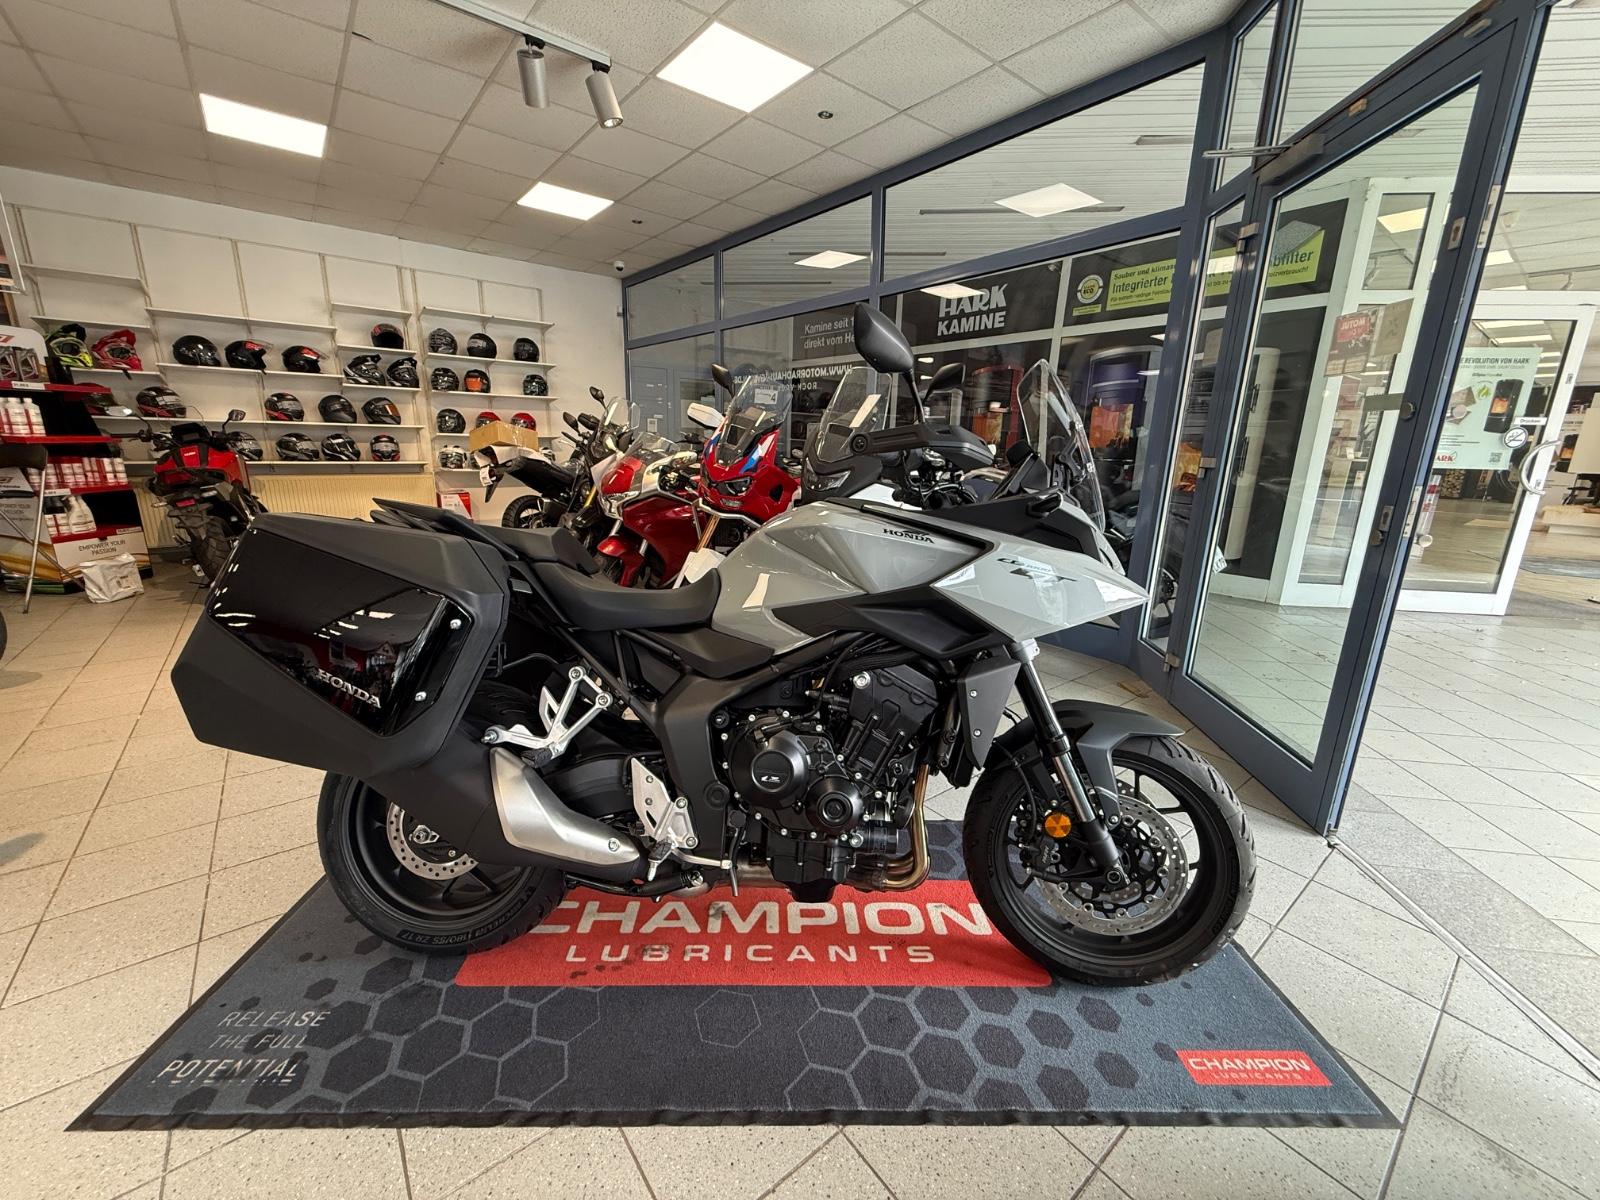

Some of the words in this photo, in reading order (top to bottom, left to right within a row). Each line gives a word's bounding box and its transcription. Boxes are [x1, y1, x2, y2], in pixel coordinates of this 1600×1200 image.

[1270, 250, 1314, 267] bfilter
[1114, 270, 1136, 281] Sauber
[1137, 267, 1150, 276] und
[1112, 275, 1168, 294] Integrierter
[939, 283, 1008, 318] HARK
[804, 321, 832, 335] Kamine
[833, 317, 849, 330] seit
[937, 311, 1006, 336] KAMINE
[803, 336, 825, 349] direkt
[826, 335, 843, 346] vom
[883, 528, 935, 544] HONDA
[78, 541, 109, 552] EMPOWER
[316, 668, 381, 709] HONDA
[528, 901, 993, 936] CHAMPION
[565, 944, 935, 963] LUBRICANTS
[217, 1011, 331, 1027] RELEASE
[208, 1034, 253, 1049] THE
[254, 1034, 308, 1049] FULL
[156, 1058, 298, 1079] POTENTIAL
[1187, 1057, 1311, 1072] CHAMPION
[1211, 1072, 1303, 1080] LUBRICANTS
